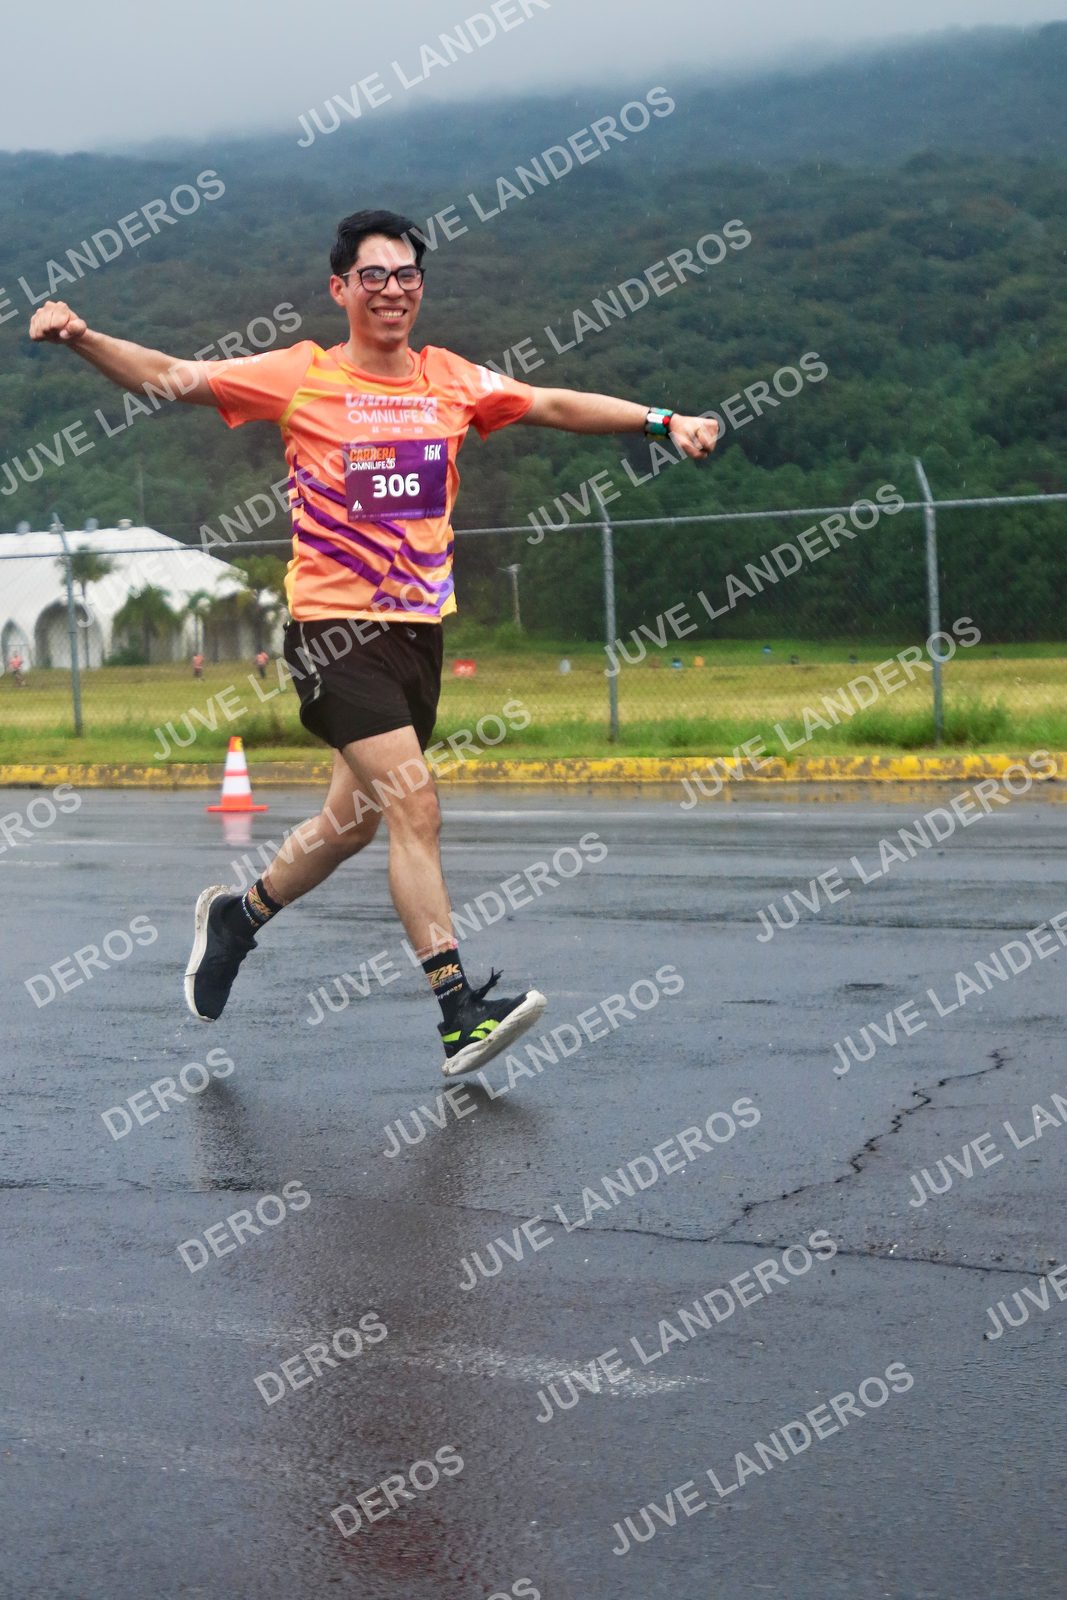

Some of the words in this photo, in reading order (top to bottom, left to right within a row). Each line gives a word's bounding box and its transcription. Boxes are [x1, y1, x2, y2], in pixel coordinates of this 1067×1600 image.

[348, 409, 421, 424] OMNILIFE
[349, 446, 396, 462] CARRERA
[372, 472, 421, 498] 306
